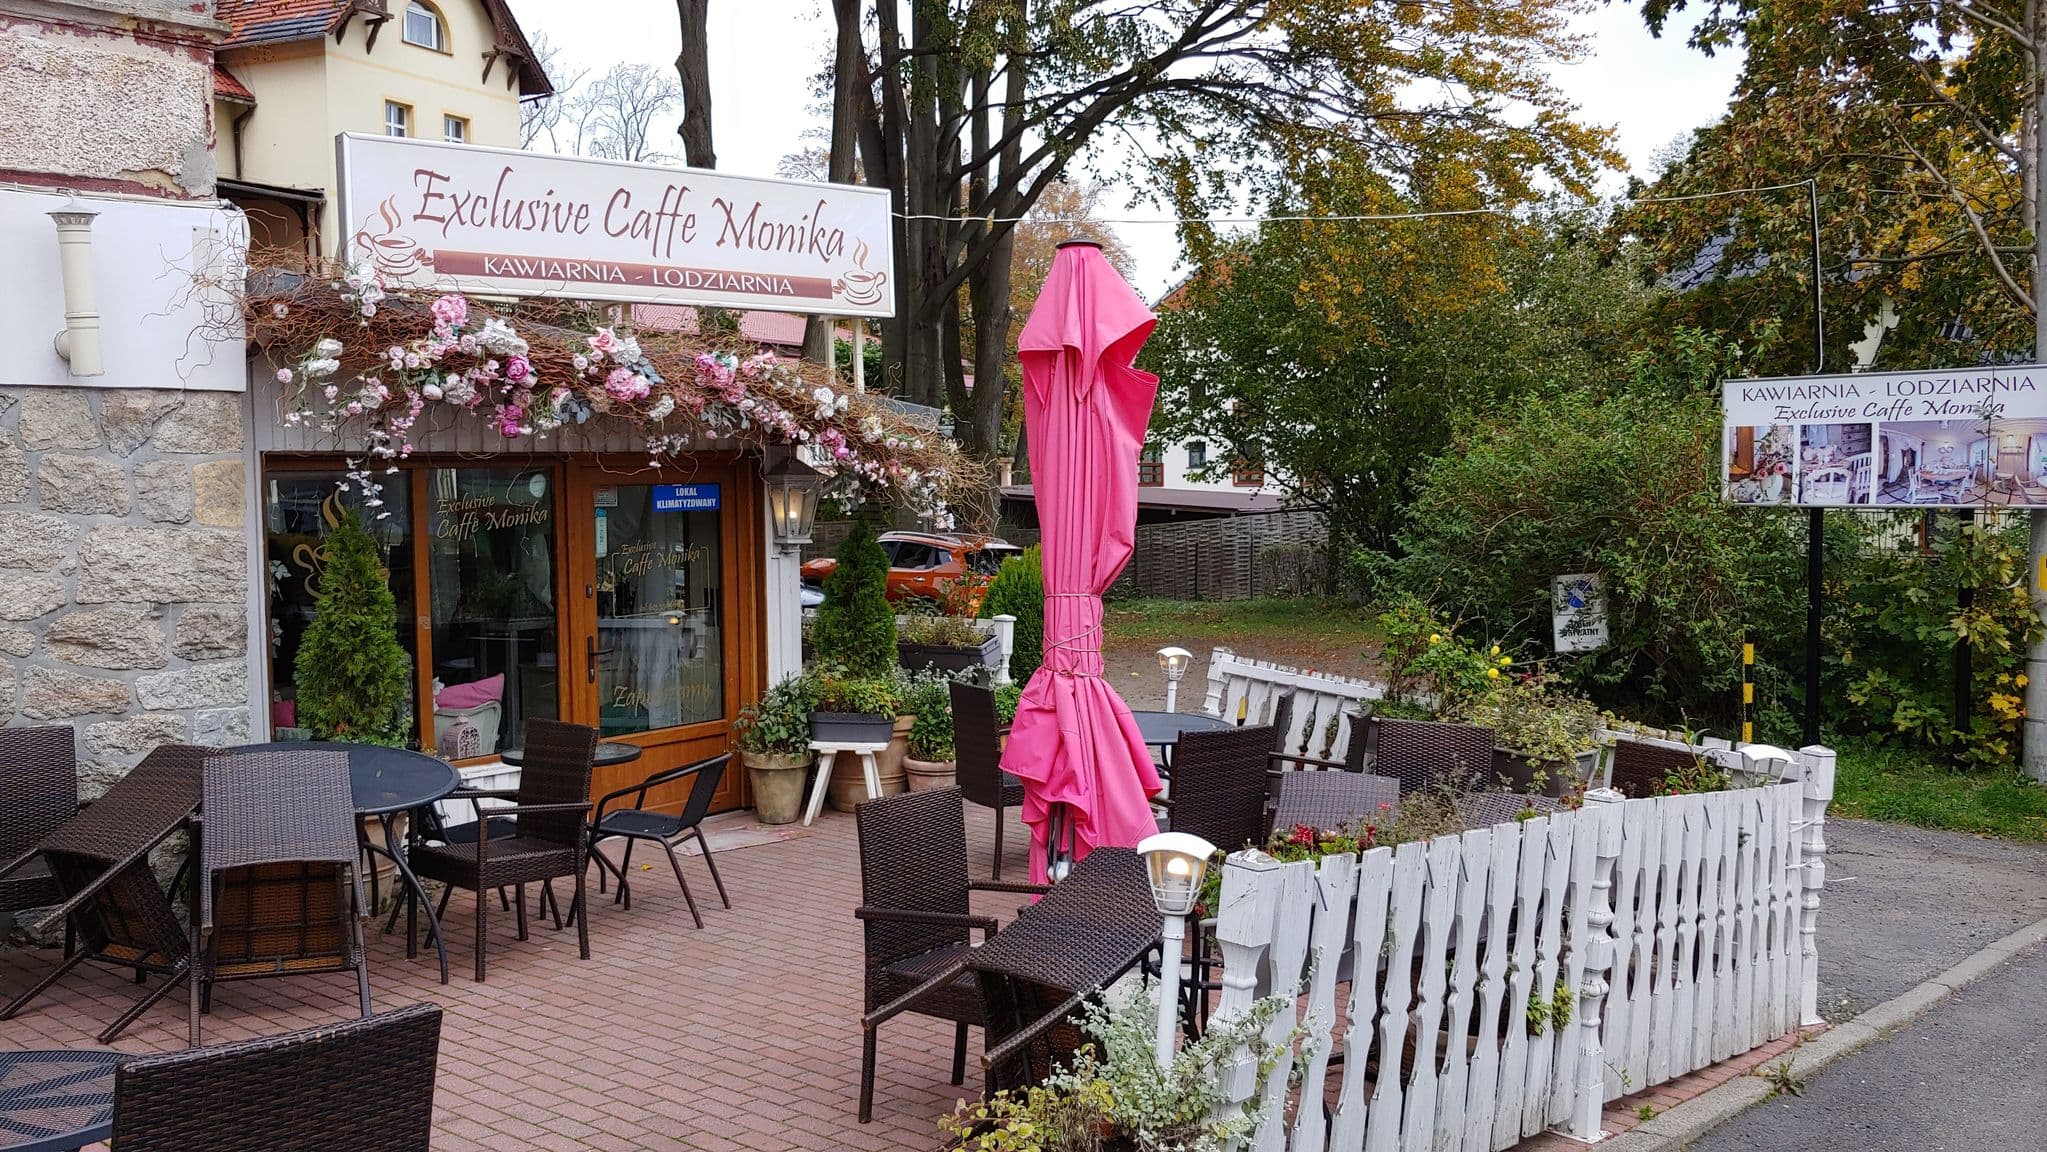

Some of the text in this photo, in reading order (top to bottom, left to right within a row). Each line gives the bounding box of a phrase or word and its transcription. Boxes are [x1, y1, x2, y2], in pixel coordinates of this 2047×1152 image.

[413, 166, 844, 264] Exclusive Caffe Monika
[483, 256, 626, 284] KAWIARNIA
[652, 266, 794, 295] LODZIARNIA
[1743, 383, 1860, 402] KAWIARNIA
[1886, 375, 2036, 398] LODZIARNIA
[1774, 401, 1857, 421] Exclusive
[1863, 398, 1913, 421] Caffe
[437, 492, 495, 516] Exclusive
[656, 498, 717, 510] KLIMATYZOWANY
[675, 487, 698, 497] LOKAL
[437, 500, 548, 541] Caffe Monika
[621, 539, 657, 555] Exclusive
[624, 552, 653, 577] Caffe
